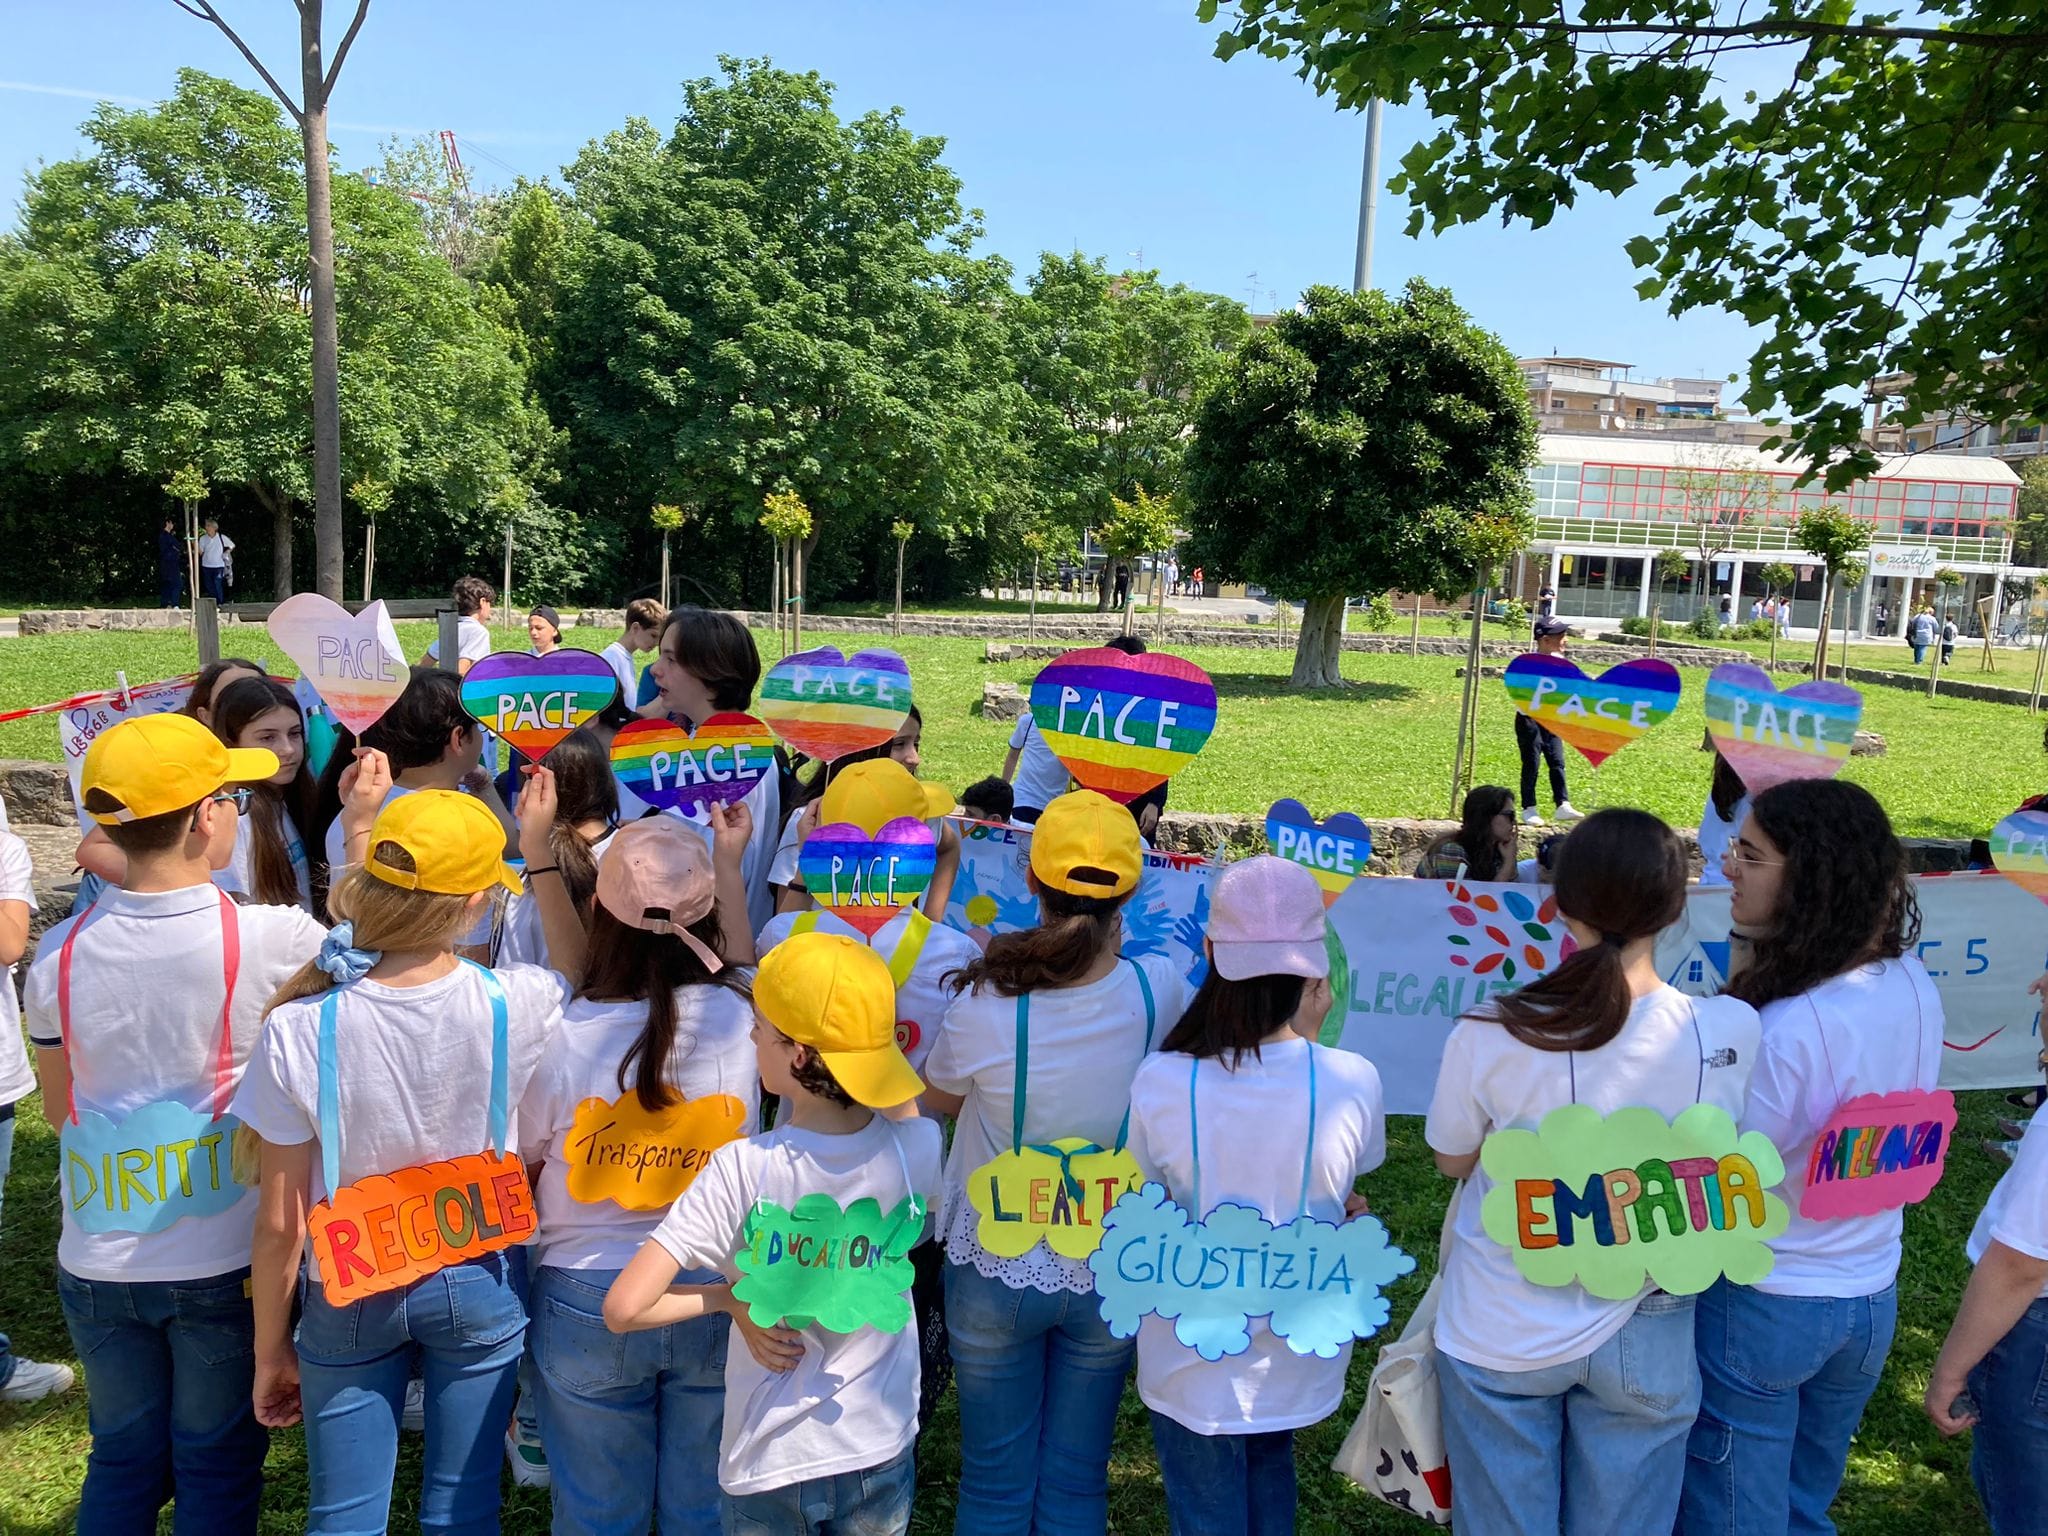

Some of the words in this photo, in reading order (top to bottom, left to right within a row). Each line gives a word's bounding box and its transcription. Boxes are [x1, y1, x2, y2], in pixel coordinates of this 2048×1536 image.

[317, 635, 398, 684] PACE
[790, 665, 895, 703] PACE
[496, 690, 579, 733] PACE
[1056, 685, 1181, 751] PACE
[1528, 675, 1653, 730] PACE
[1733, 697, 1829, 753] PACE
[650, 742, 759, 792] PACE
[958, 820, 1017, 845] VOCE
[1277, 824, 1355, 874] PACE
[829, 854, 901, 908] PACE
[1965, 938, 1990, 975] 5
[68, 1128, 240, 1212] DIRITT
[990, 1173, 1138, 1226] LEALT
[1515, 1153, 1766, 1250] EMPATIA
[325, 1171, 531, 1288] REGOLE
[1117, 1233, 1354, 1294] GIUSTIZIA
